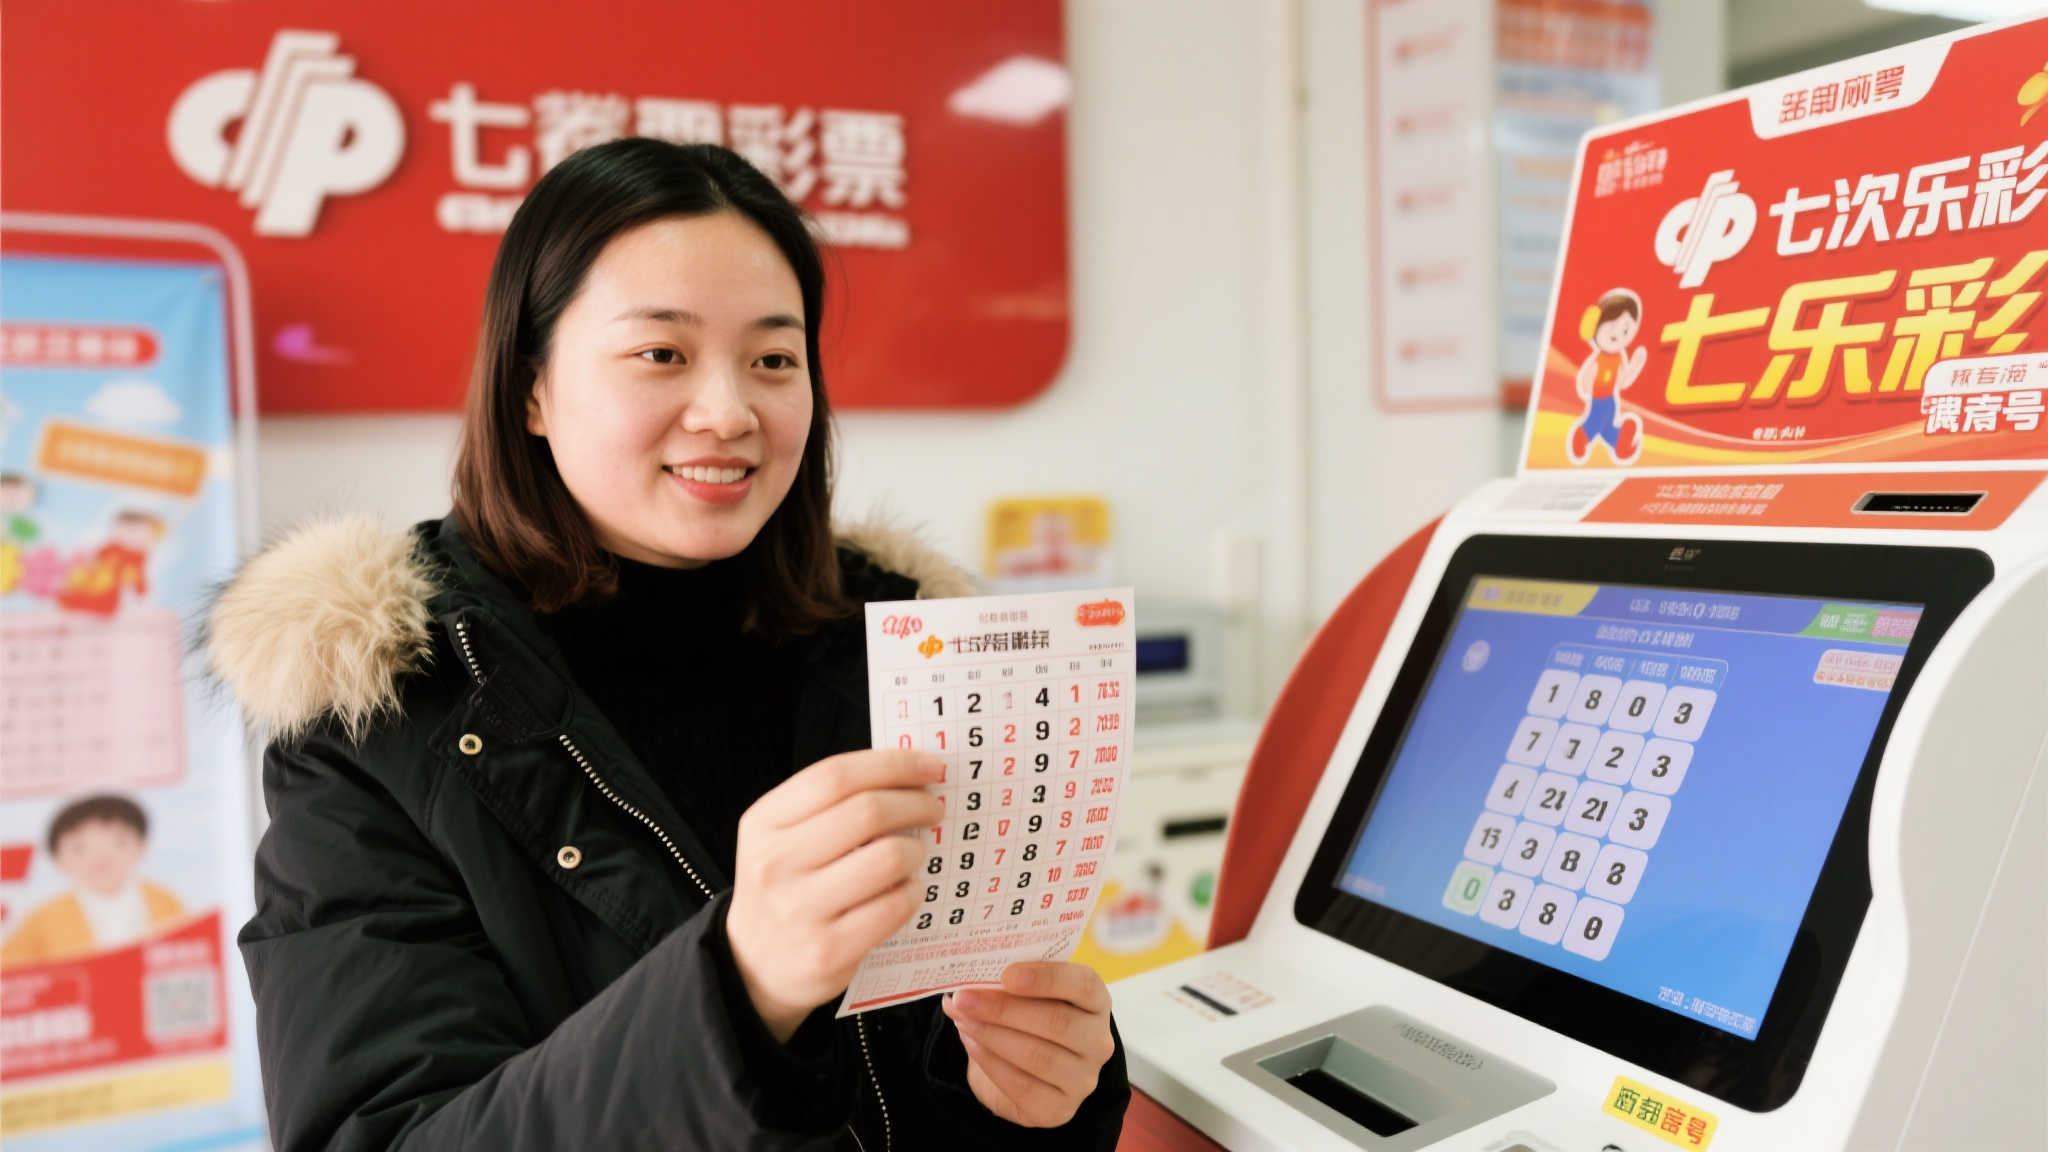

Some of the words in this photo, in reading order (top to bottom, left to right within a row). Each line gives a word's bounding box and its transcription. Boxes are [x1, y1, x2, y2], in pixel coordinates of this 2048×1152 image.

[1768, 139, 2048, 258] 七次乐彩
[1660, 250, 2048, 405] 七乐彩
[933, 696, 944, 716] 1
[967, 693, 982, 713] 2
[1035, 687, 1050, 707] 4
[1071, 684, 1080, 703] 1
[1547, 684, 1560, 704] 1
[1584, 689, 1602, 710] 8
[1627, 696, 1646, 717] 0
[936, 730, 946, 750] 1
[968, 726, 983, 747] 5
[1003, 724, 1017, 743] 2
[1036, 720, 1050, 741] 9
[1069, 717, 1081, 736] 2
[969, 760, 983, 780] 7
[1003, 757, 1016, 776] 2
[1034, 753, 1049, 773] 9
[1068, 749, 1081, 769] 7
[1526, 731, 1541, 752] 7
[1604, 746, 1624, 768] 2
[1651, 755, 1672, 778] 3
[1028, 814, 1043, 833] 9
[1581, 797, 1608, 822] 21
[1629, 808, 1649, 831] 3
[927, 856, 943, 875] 8
[960, 851, 975, 870] 9
[994, 847, 1006, 866] 7
[1022, 843, 1038, 861] 8
[1055, 838, 1068, 855] 7
[1463, 877, 1481, 901] 0
[1538, 902, 1557, 925] 8
